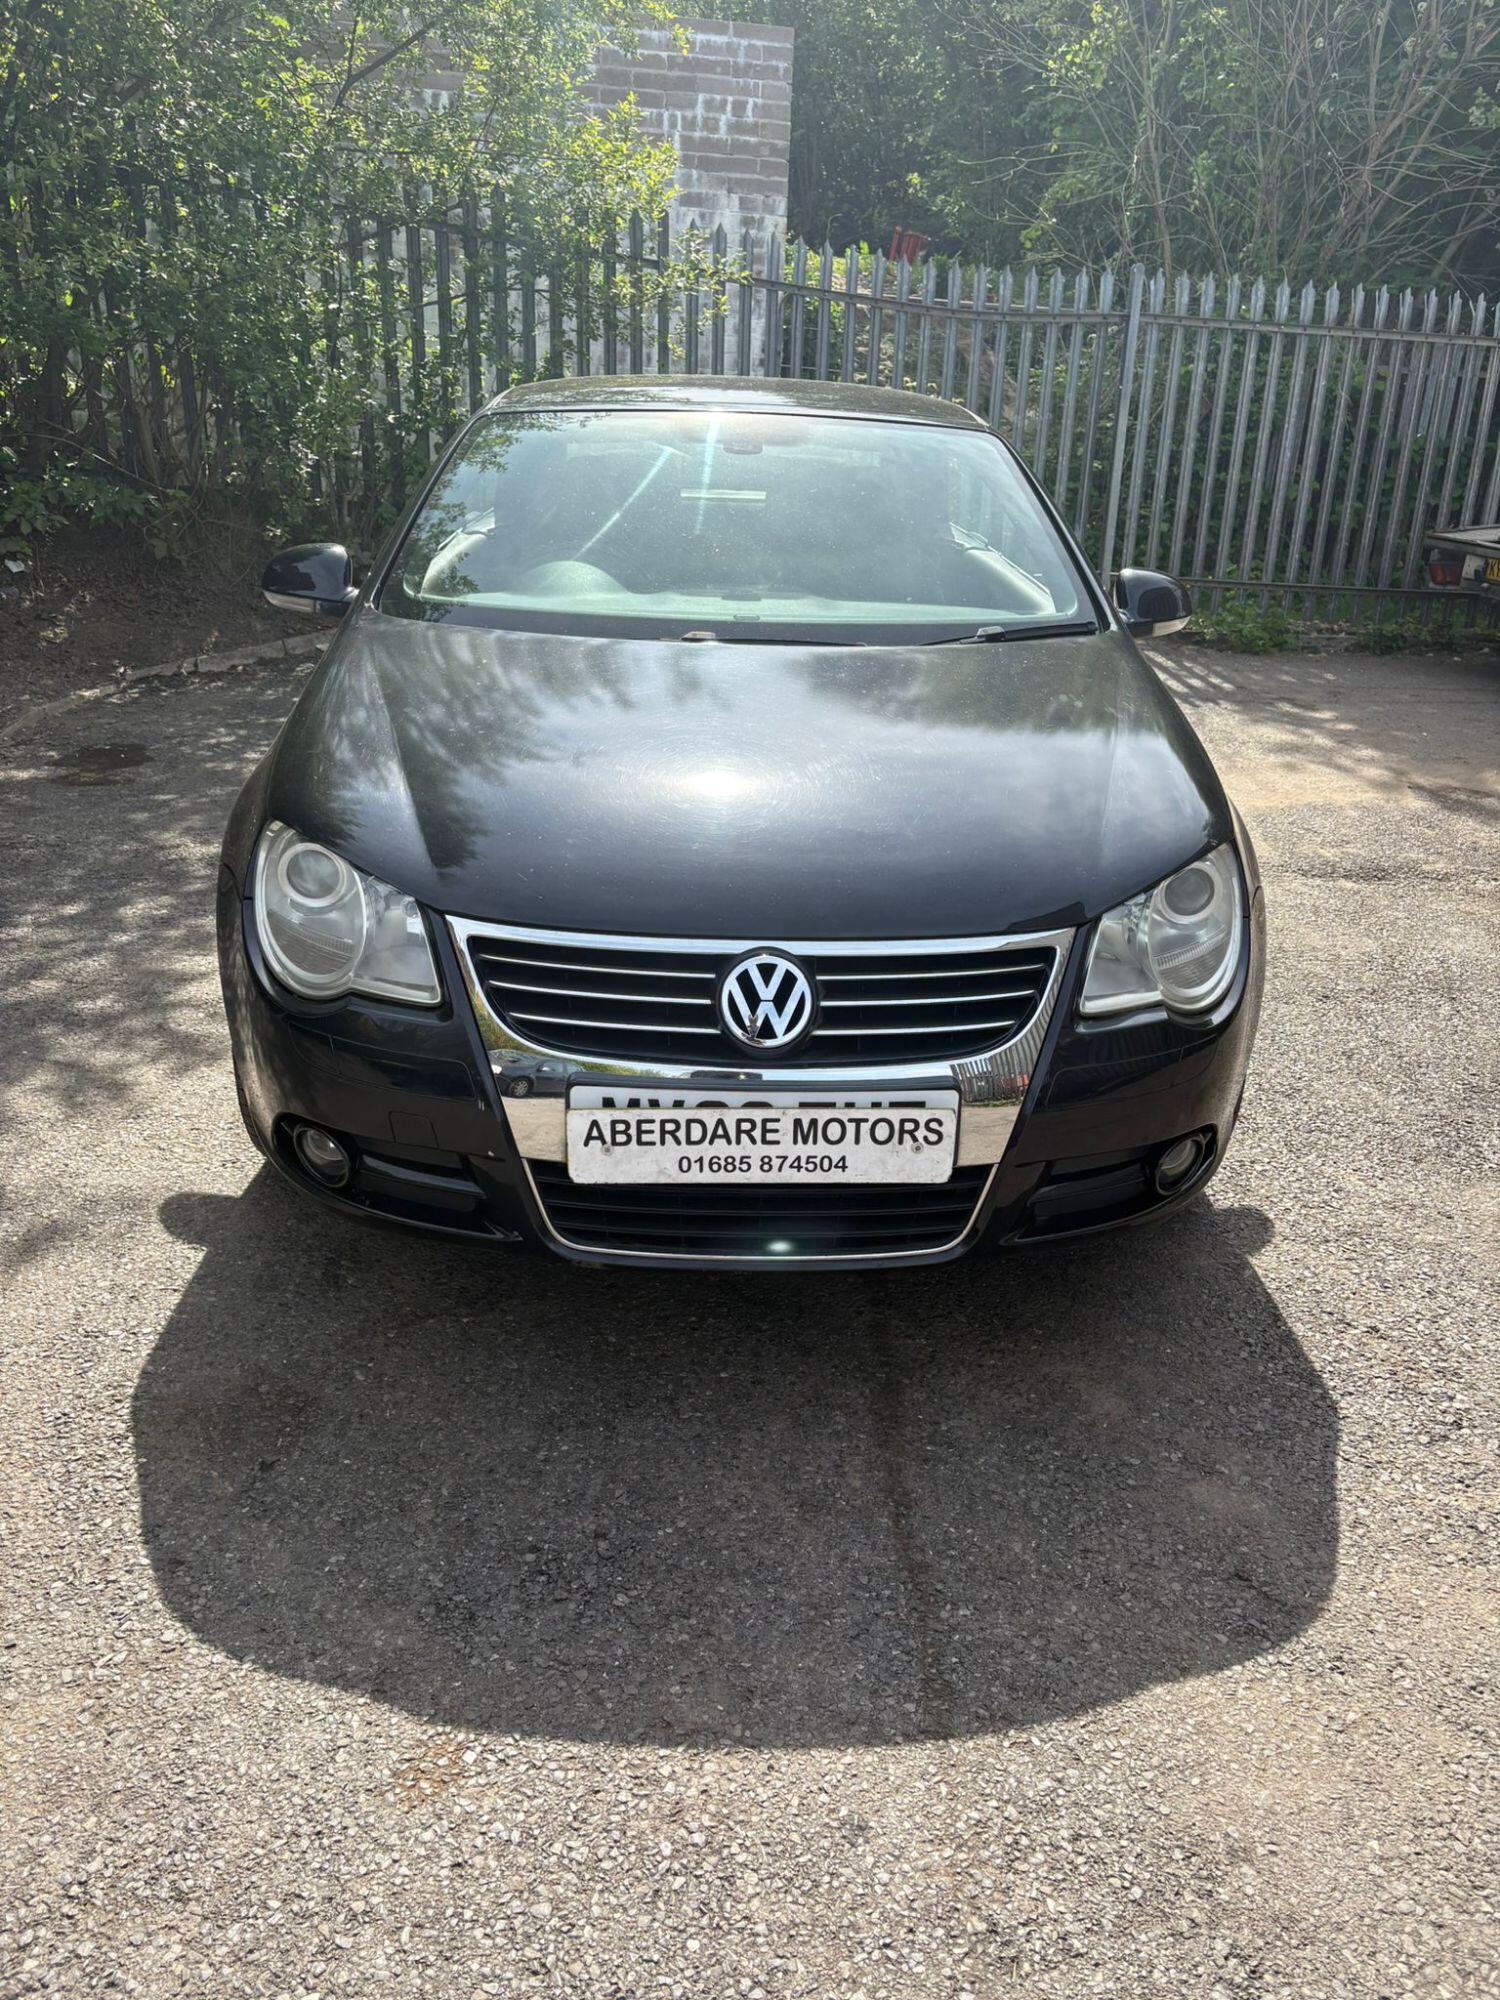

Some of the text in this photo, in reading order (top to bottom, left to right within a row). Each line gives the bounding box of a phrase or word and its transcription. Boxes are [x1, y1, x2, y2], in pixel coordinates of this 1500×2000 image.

[722, 956, 812, 1048] VW
[583, 1117, 944, 1147] ABERDARE MOTORS
[678, 1155, 848, 1174] 01685 874504
